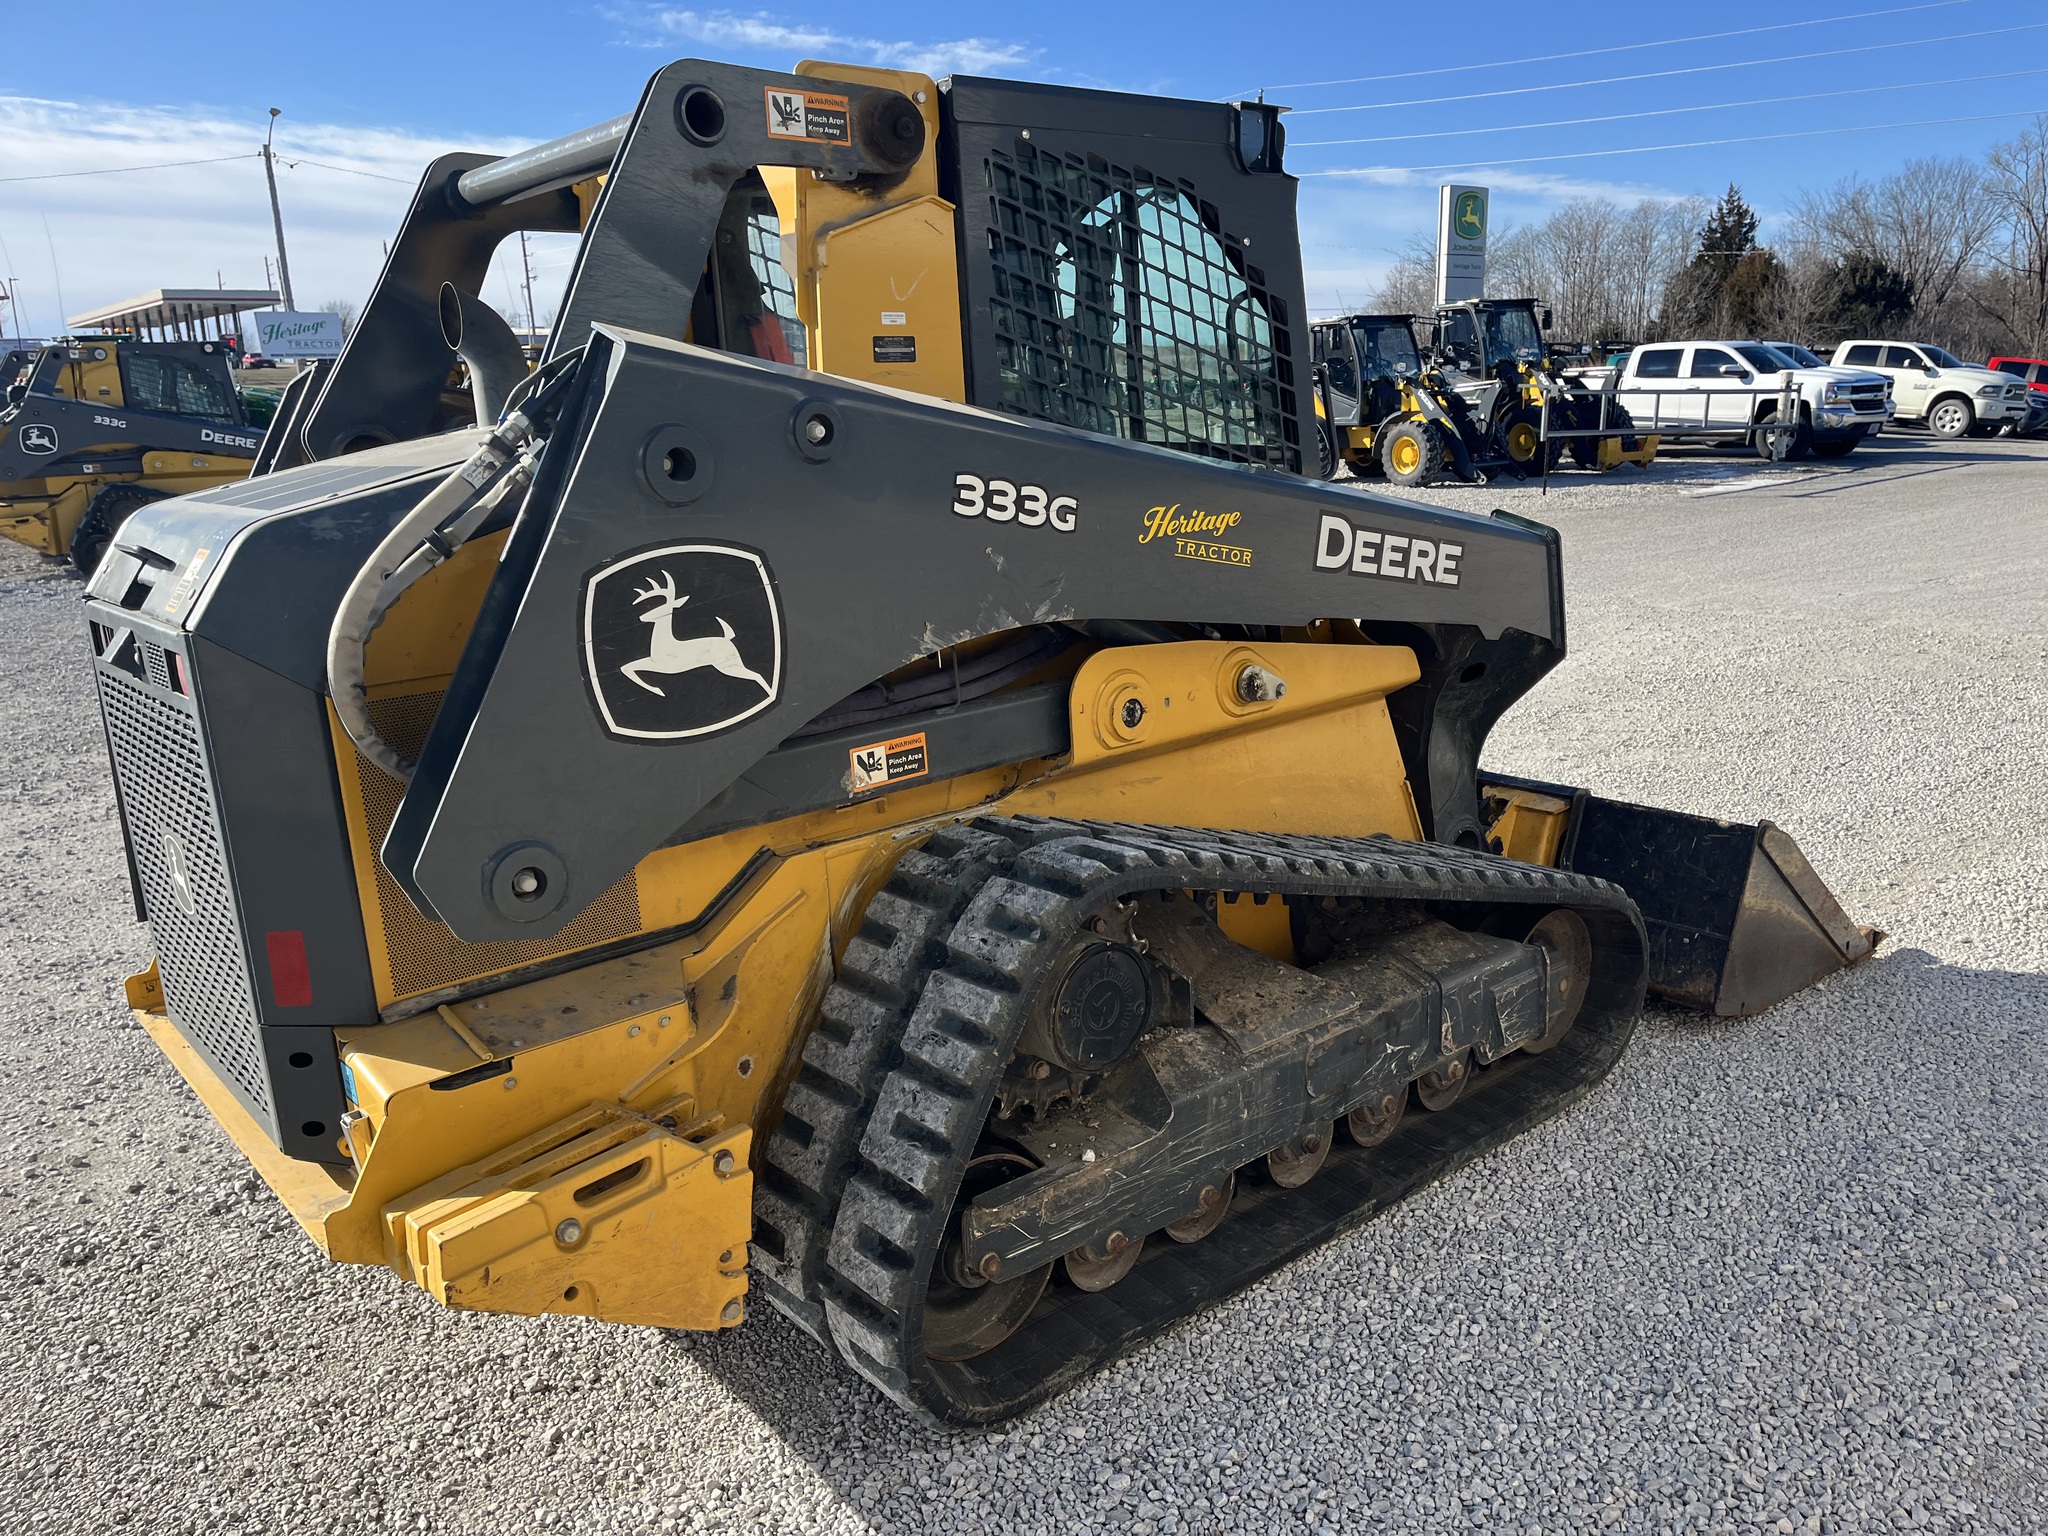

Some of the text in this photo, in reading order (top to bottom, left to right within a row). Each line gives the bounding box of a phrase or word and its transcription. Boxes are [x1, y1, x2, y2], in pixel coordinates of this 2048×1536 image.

[808, 114, 844, 125] Pinch Area
[824, 128, 840, 136] Away
[1452, 243, 1484, 252] JOHN DEERE
[262, 320, 326, 345] Heritage
[287, 340, 340, 348] TRACTOR
[93, 415, 127, 429] 333G
[201, 428, 257, 449] DEERE
[953, 474, 1078, 532] 333G
[1138, 503, 1242, 544] Heritage
[1176, 540, 1252, 564] TRACTOR
[1316, 515, 1463, 585] DEERE
[894, 738, 922, 748] WARNING
[888, 753, 922, 766] Pinch Area
